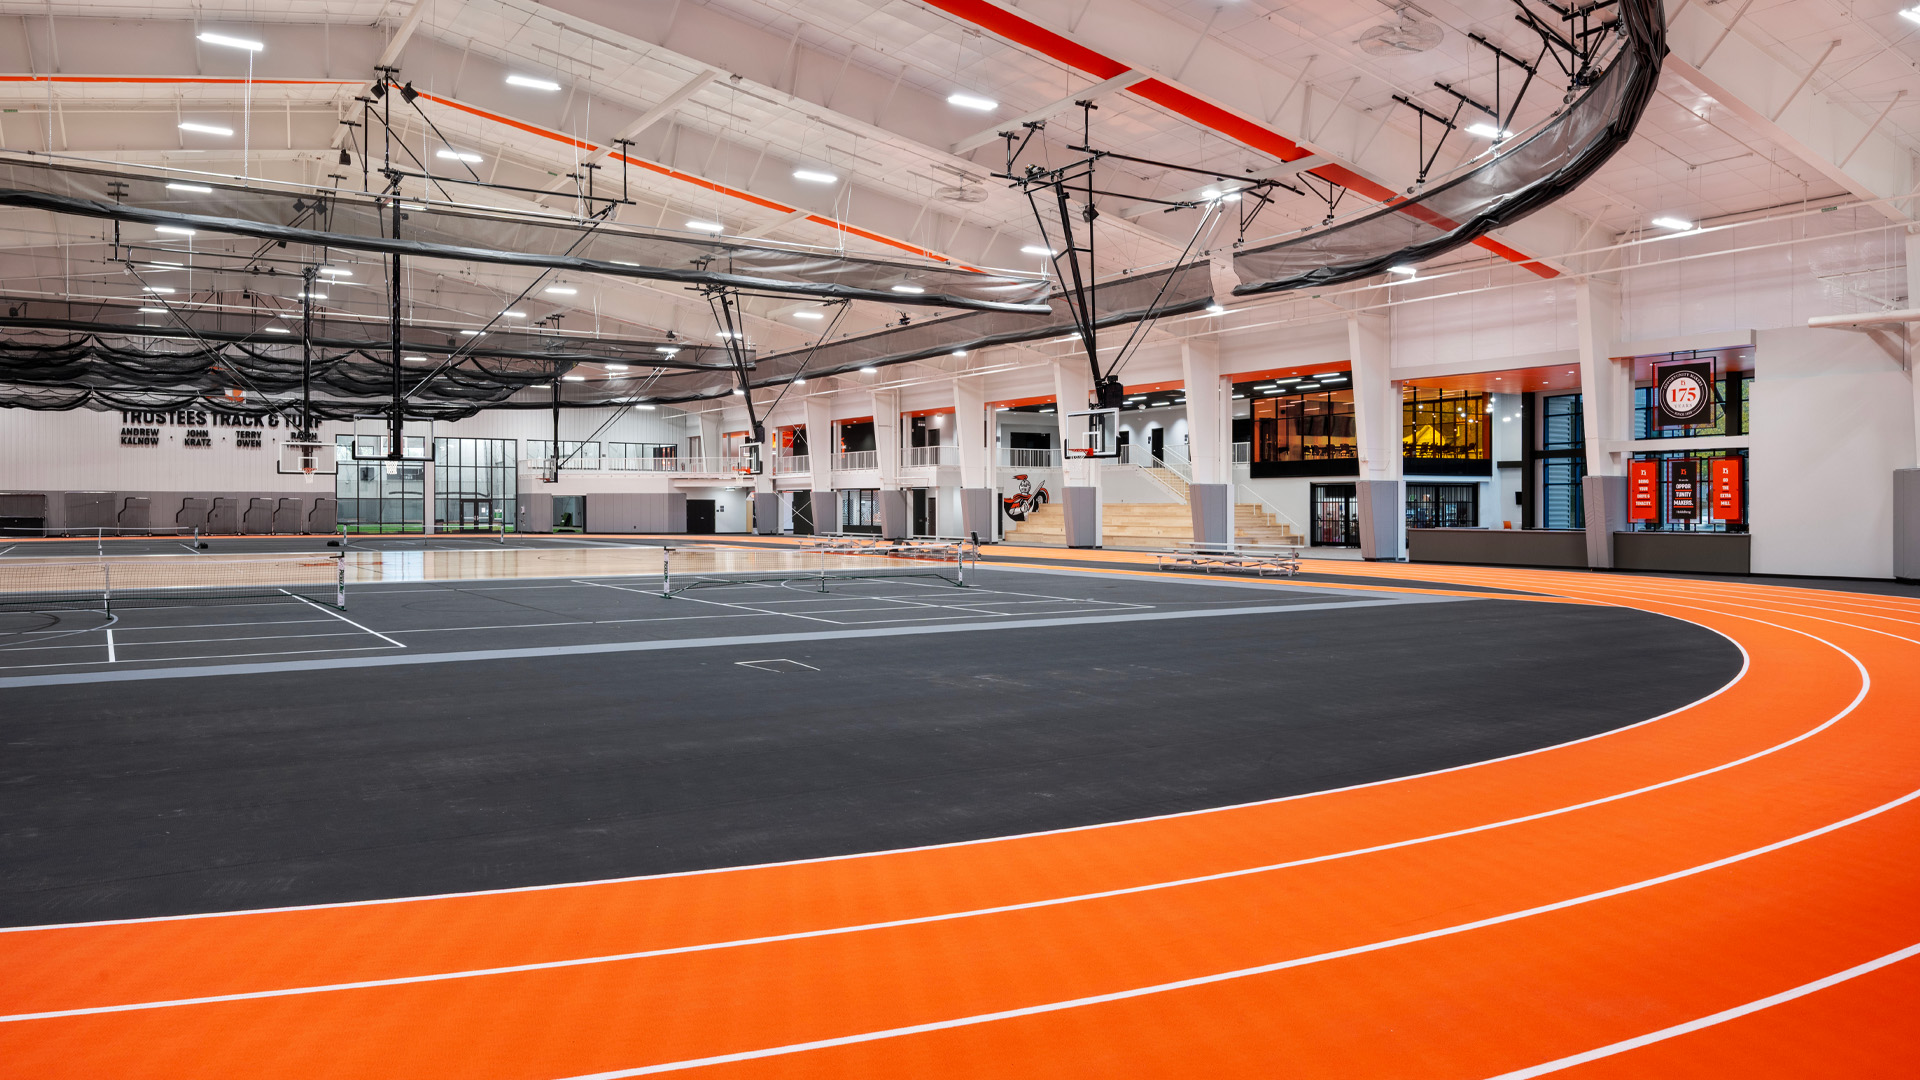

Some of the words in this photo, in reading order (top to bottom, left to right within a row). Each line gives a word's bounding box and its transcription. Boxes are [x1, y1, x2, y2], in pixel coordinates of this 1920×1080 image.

[1672, 388, 1696, 402] 175
[121, 411, 207, 426] TRUSTEES
[211, 411, 264, 428] TRACK
[268, 413, 279, 428] &
[121, 428, 159, 437] ANDREW
[186, 429, 209, 438] JOHN
[236, 430, 262, 439] TERRY
[121, 437, 159, 446] KALNOW
[184, 438, 211, 447] KRATZ
[236, 439, 261, 448] OWEN
